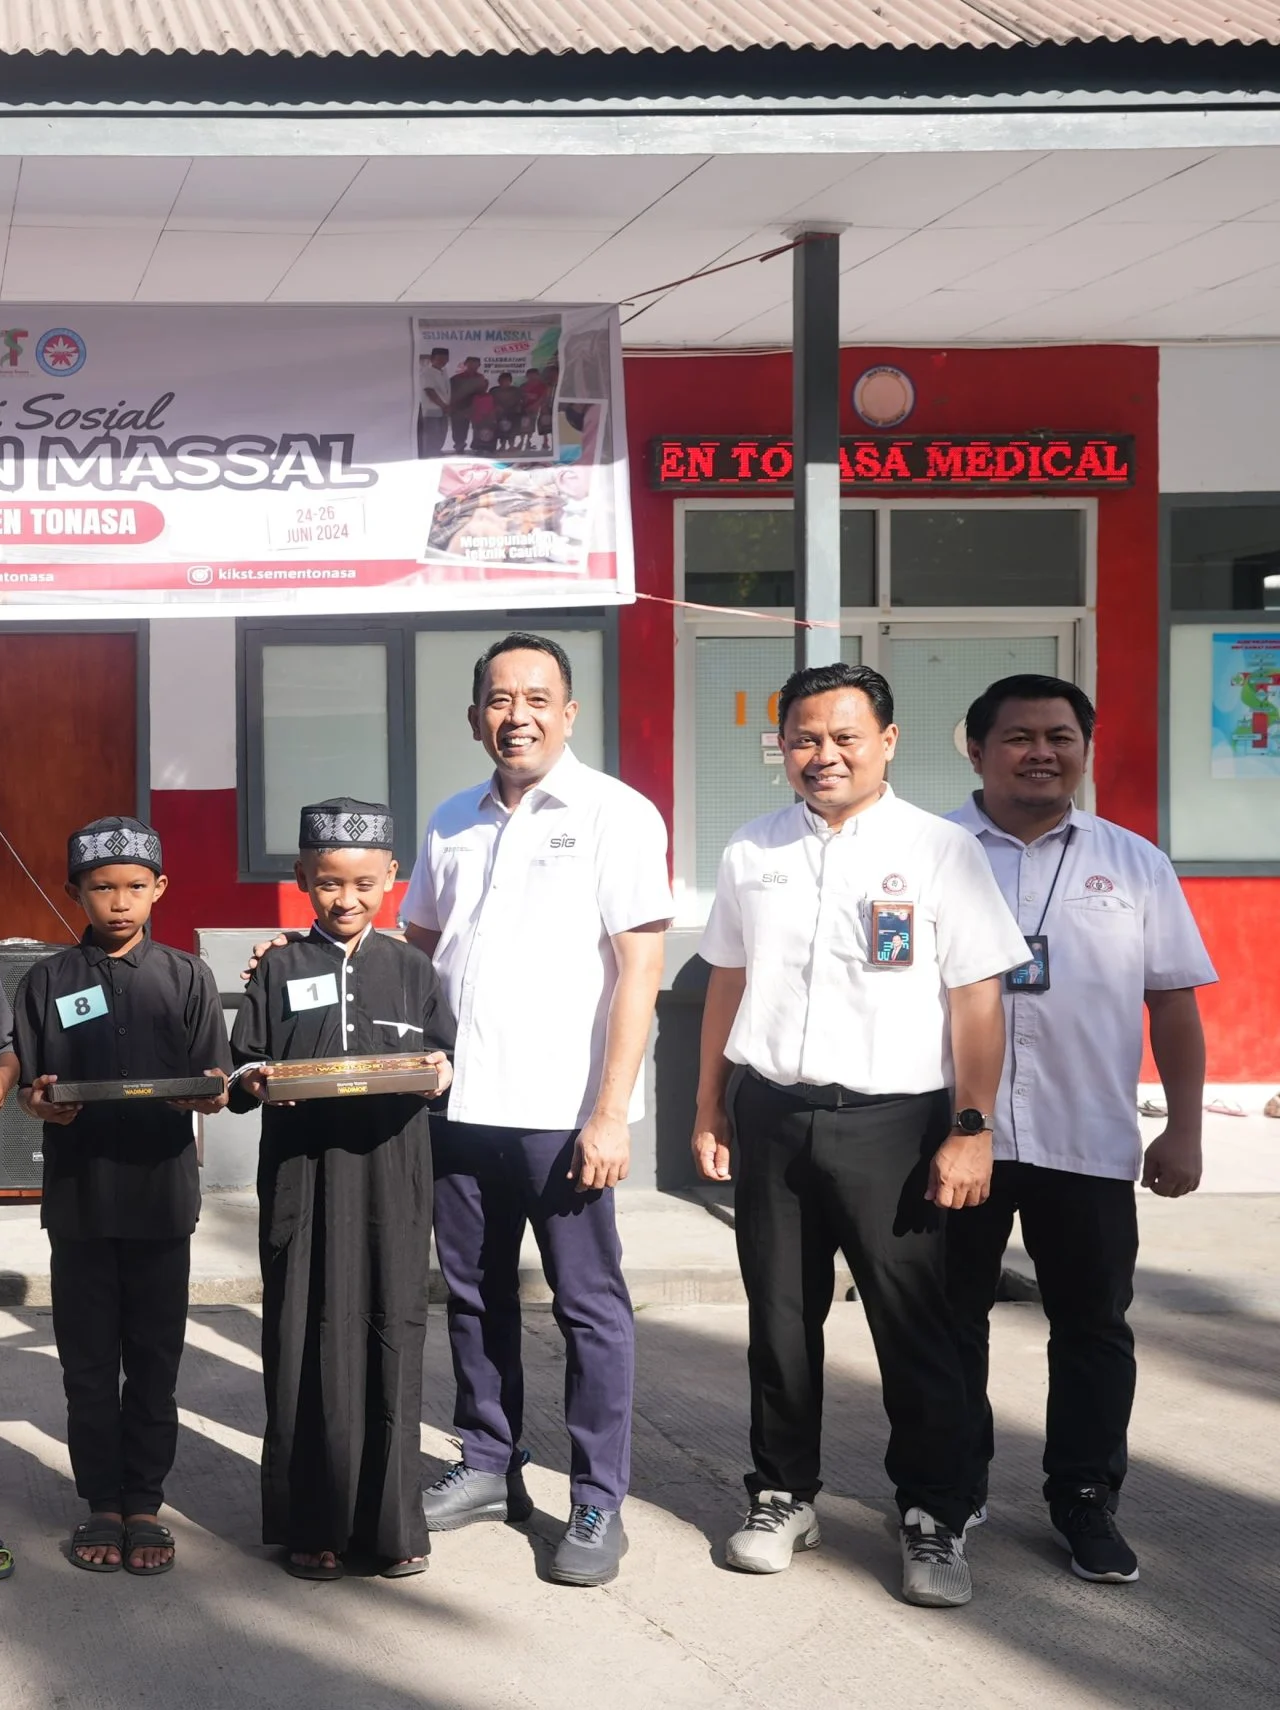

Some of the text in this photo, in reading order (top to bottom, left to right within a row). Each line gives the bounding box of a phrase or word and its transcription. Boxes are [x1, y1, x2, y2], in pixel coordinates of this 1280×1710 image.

[15, 391, 176, 436] Sosial
[37, 432, 379, 493] MASSAL
[730, 446, 911, 478] TOASA
[924, 445, 1128, 477] MEDICAL
[30, 507, 137, 535] TONASA
[296, 505, 335, 523] 24-26
[286, 523, 350, 544] JUNI 2024
[218, 567, 357, 580] kikst.sementonasa
[306, 983, 320, 1002] 1
[74, 996, 91, 1016] 8
